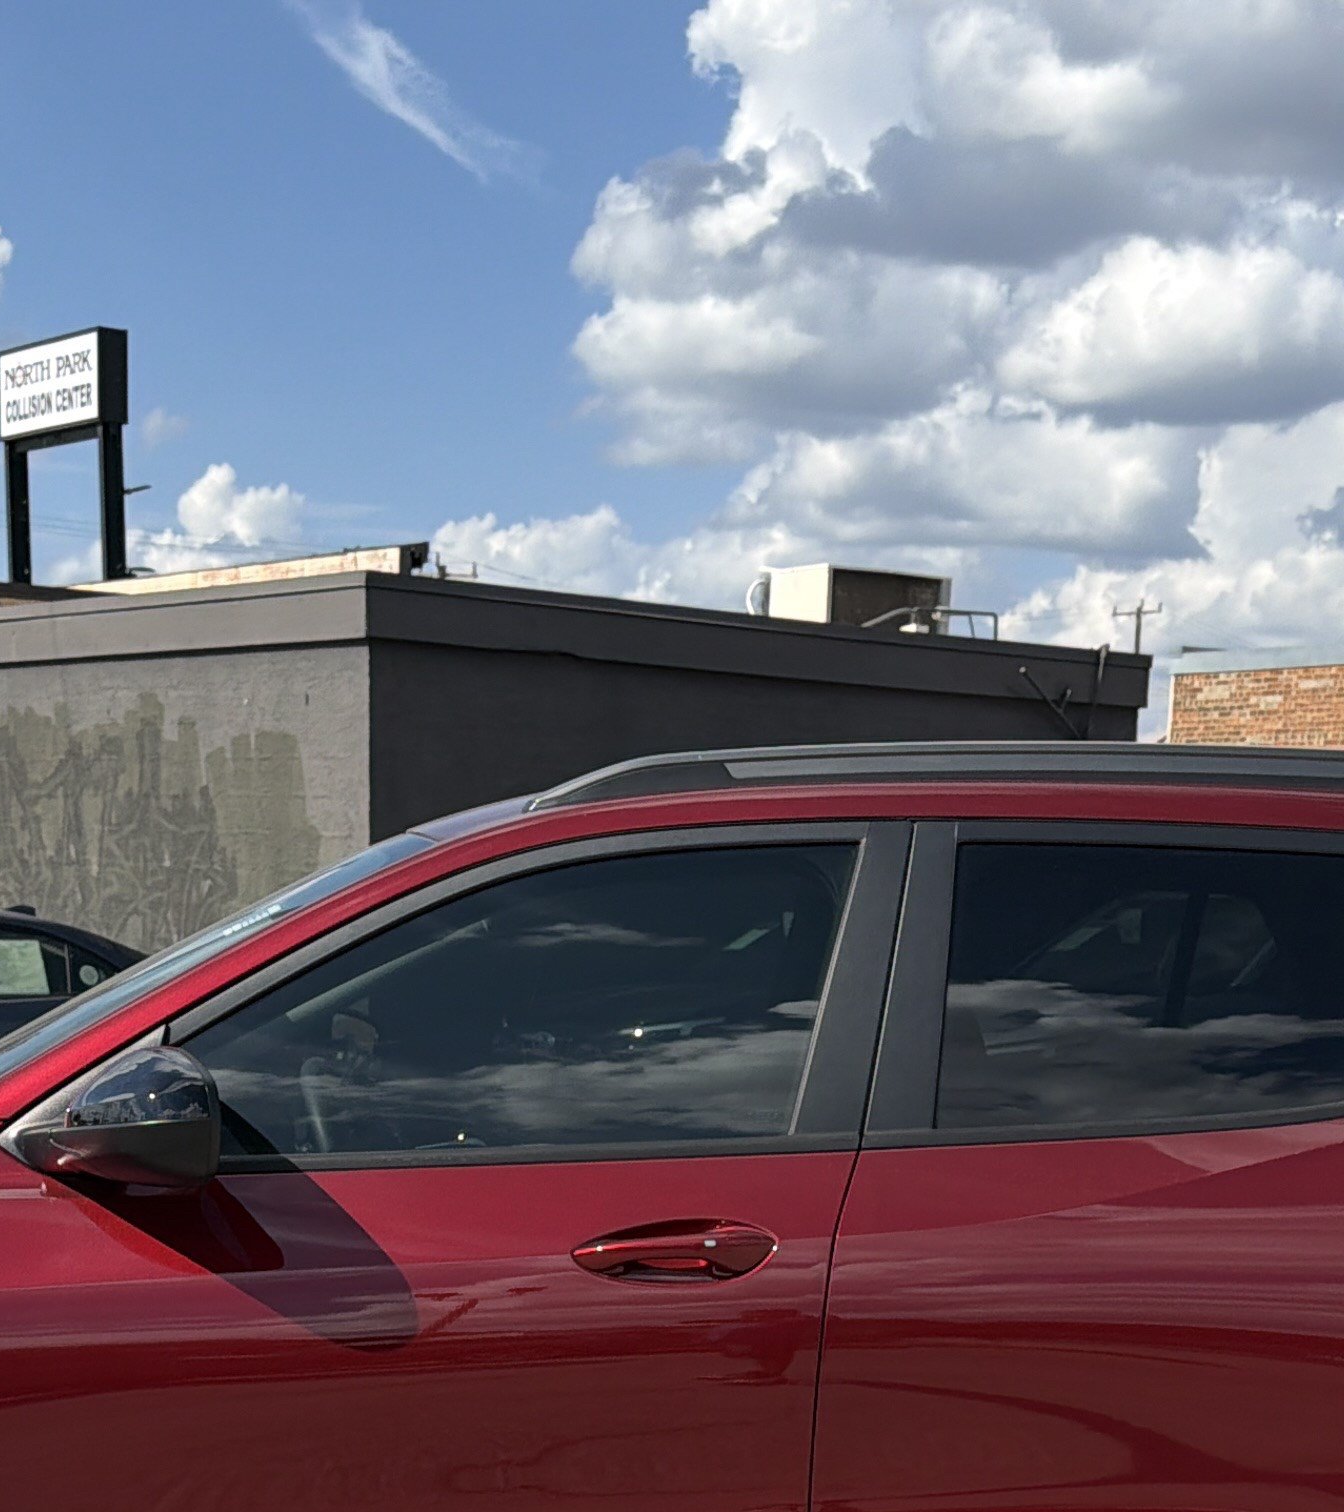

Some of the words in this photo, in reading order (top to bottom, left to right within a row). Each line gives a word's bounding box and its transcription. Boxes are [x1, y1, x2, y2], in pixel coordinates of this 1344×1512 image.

[4, 358, 51, 390] NORTH
[55, 349, 93, 378] PARK
[5, 392, 53, 424] COLLISION
[55, 383, 92, 412] CENTER
